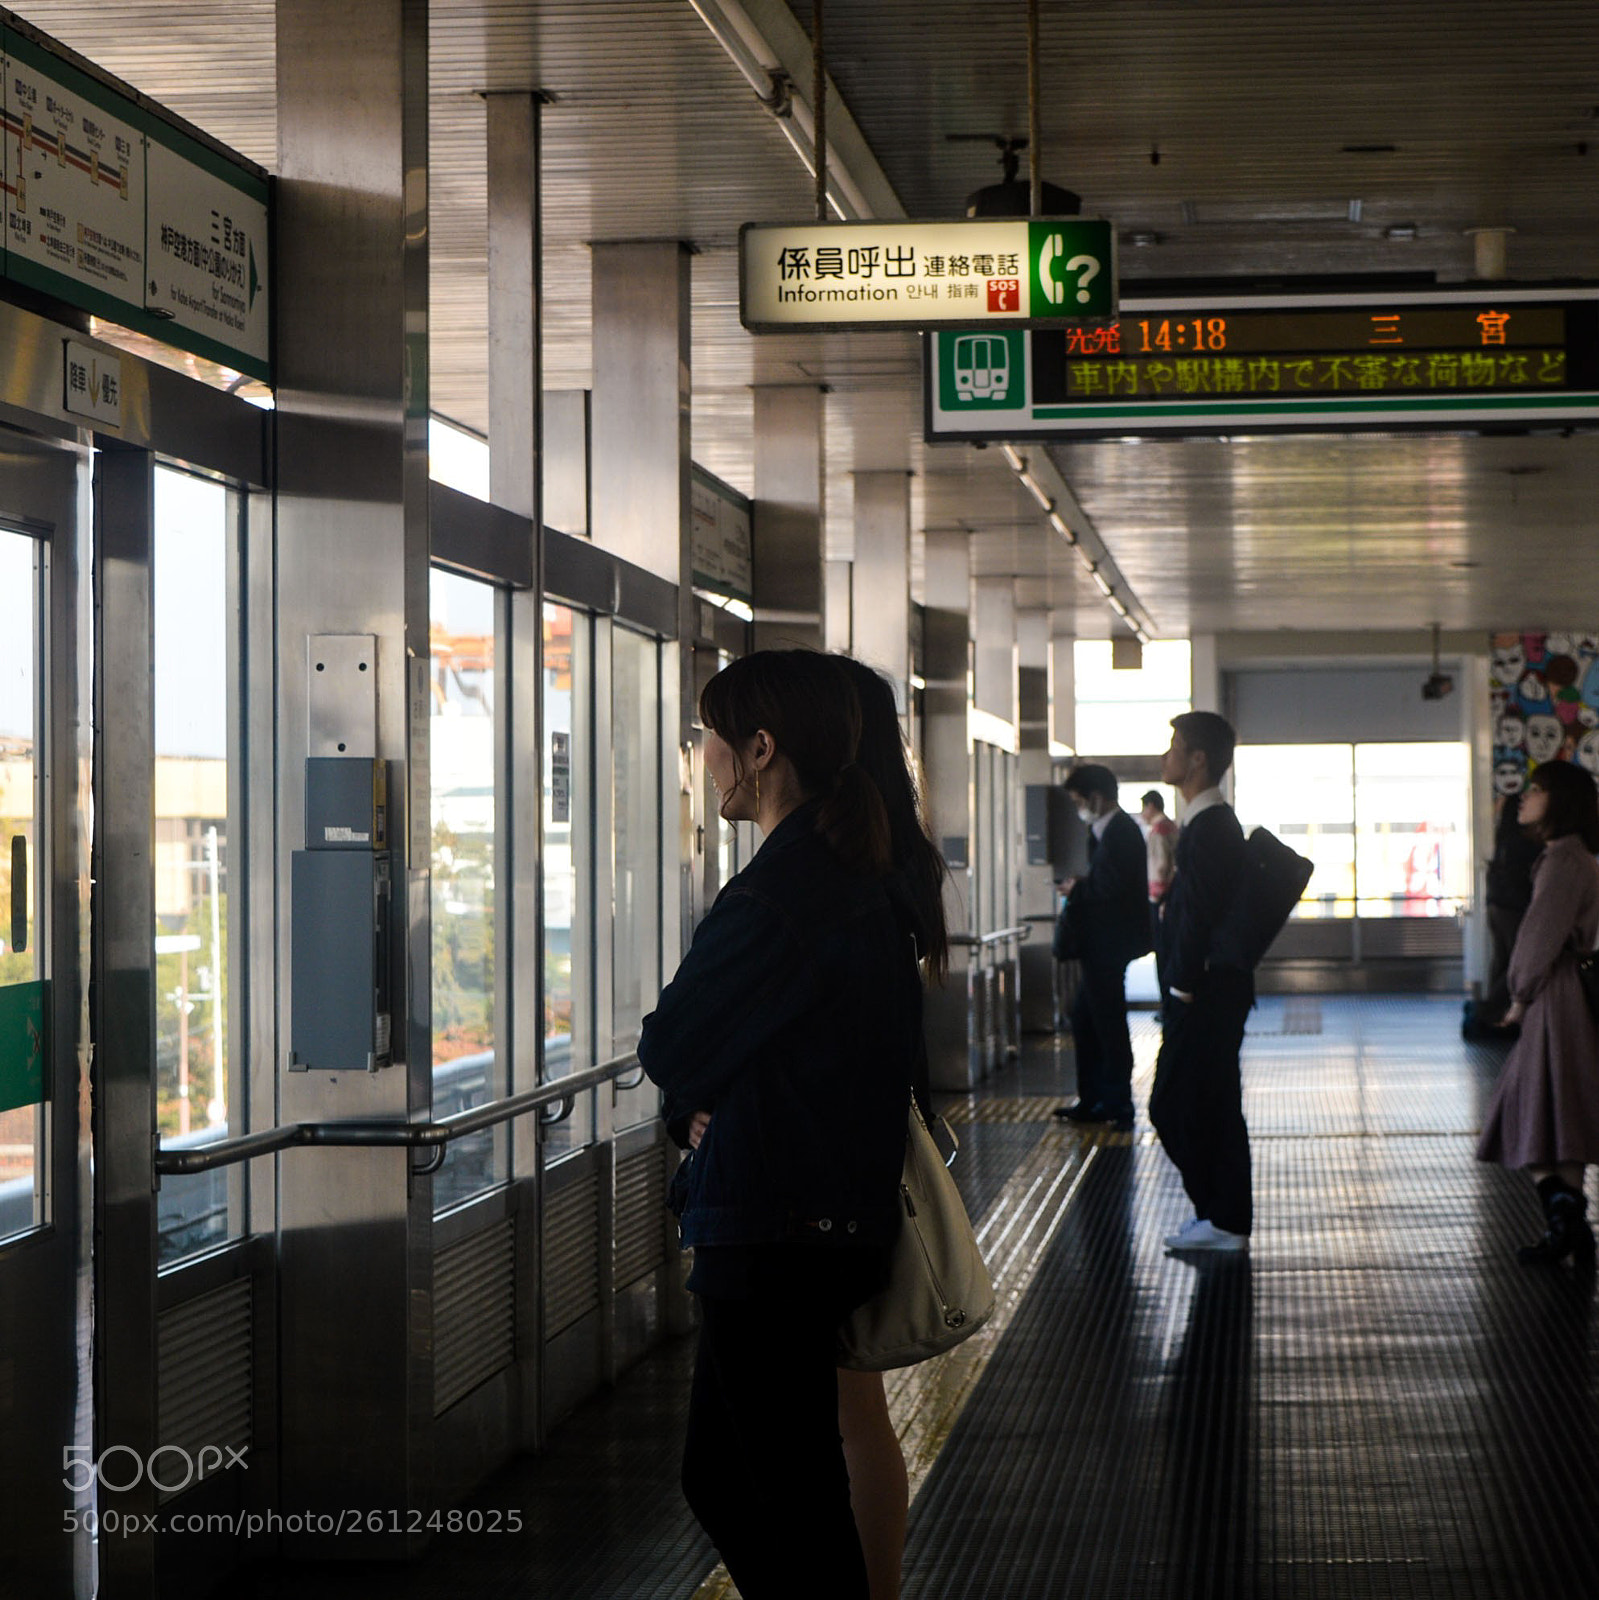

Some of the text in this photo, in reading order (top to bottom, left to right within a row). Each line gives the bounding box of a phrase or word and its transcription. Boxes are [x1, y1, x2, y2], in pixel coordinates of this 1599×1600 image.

[211, 209, 246, 258] 三宮方面
[777, 245, 1020, 281] 係員呼出 連絡電話
[777, 283, 980, 303] Information 안내 指南
[989, 280, 1017, 291] SOS
[1066, 324, 1121, 355] 先発
[1139, 318, 1227, 352] 14:18
[1070, 352, 1566, 395] 車内や駅構内で不審な荷物など
